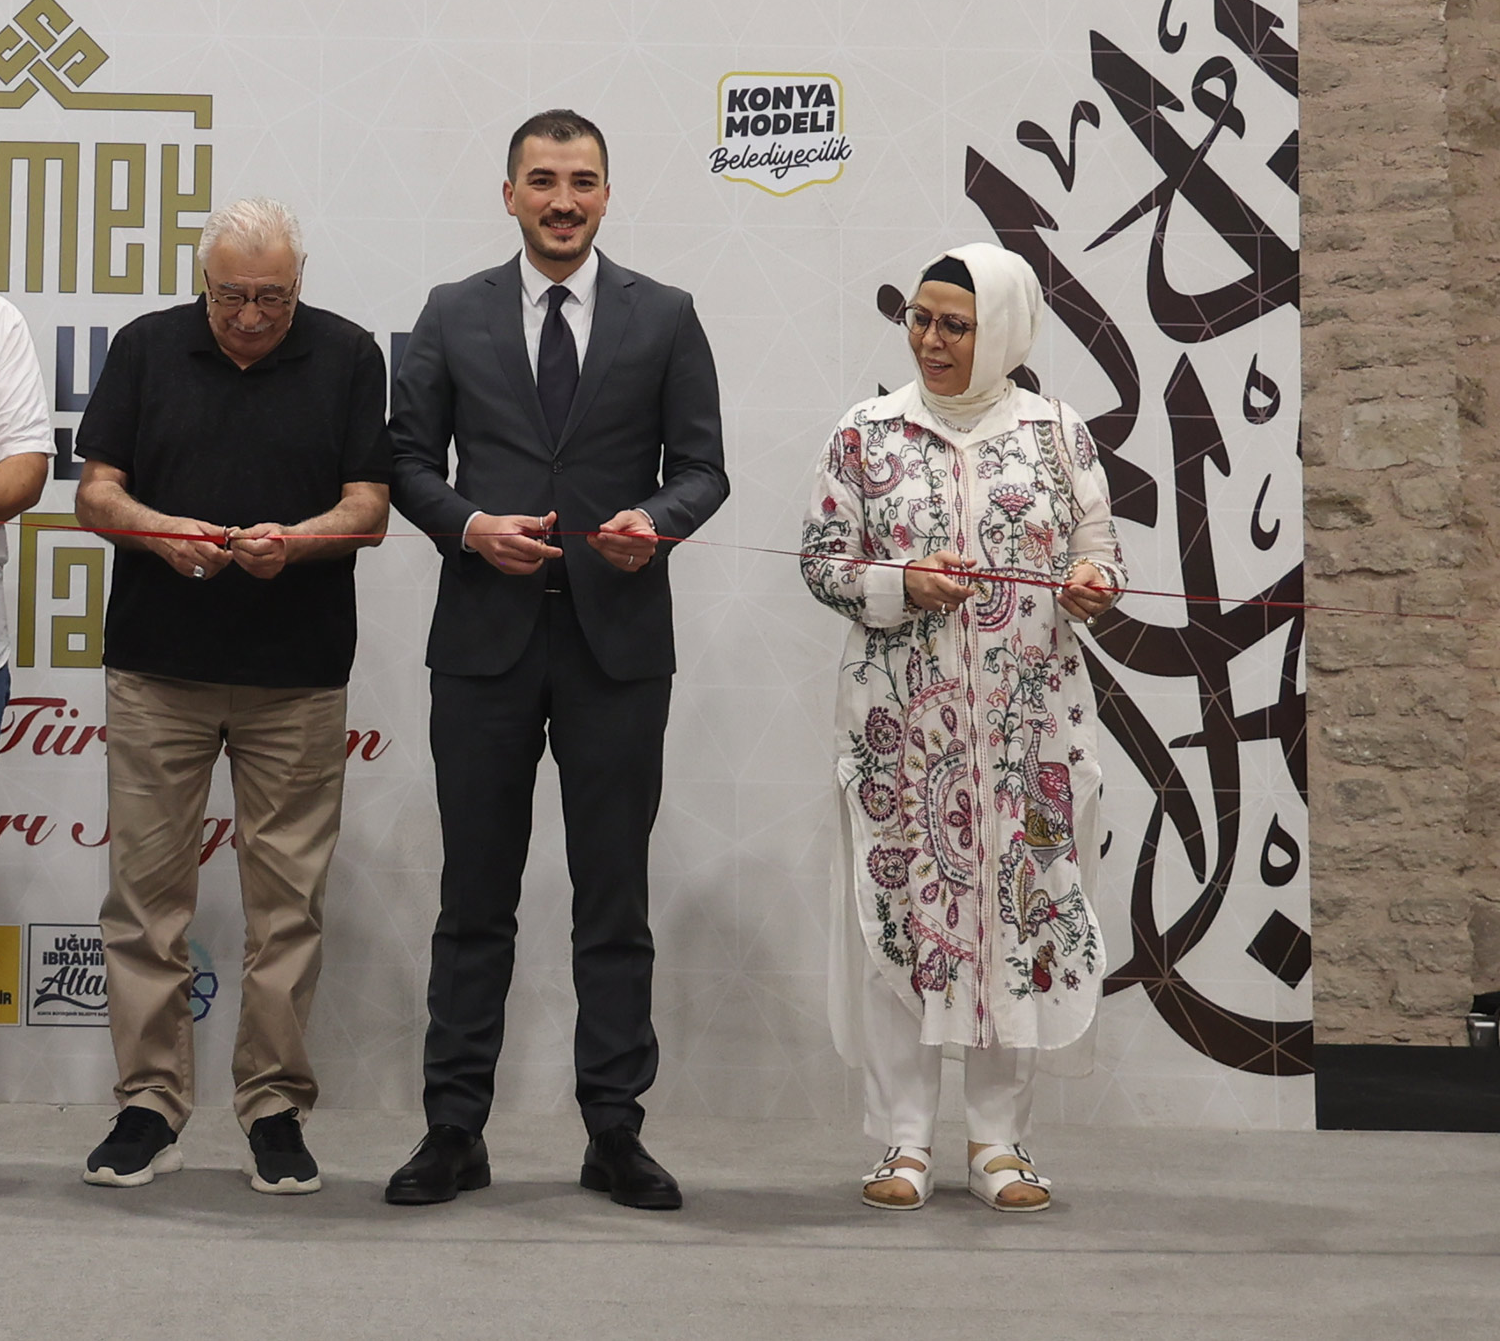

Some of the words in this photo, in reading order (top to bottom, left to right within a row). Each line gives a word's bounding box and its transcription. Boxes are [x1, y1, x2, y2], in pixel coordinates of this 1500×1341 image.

[727, 84, 836, 113] KONYA
[709, 136, 852, 179] Belediyecilik
[55, 934, 103, 951] UĞUR
